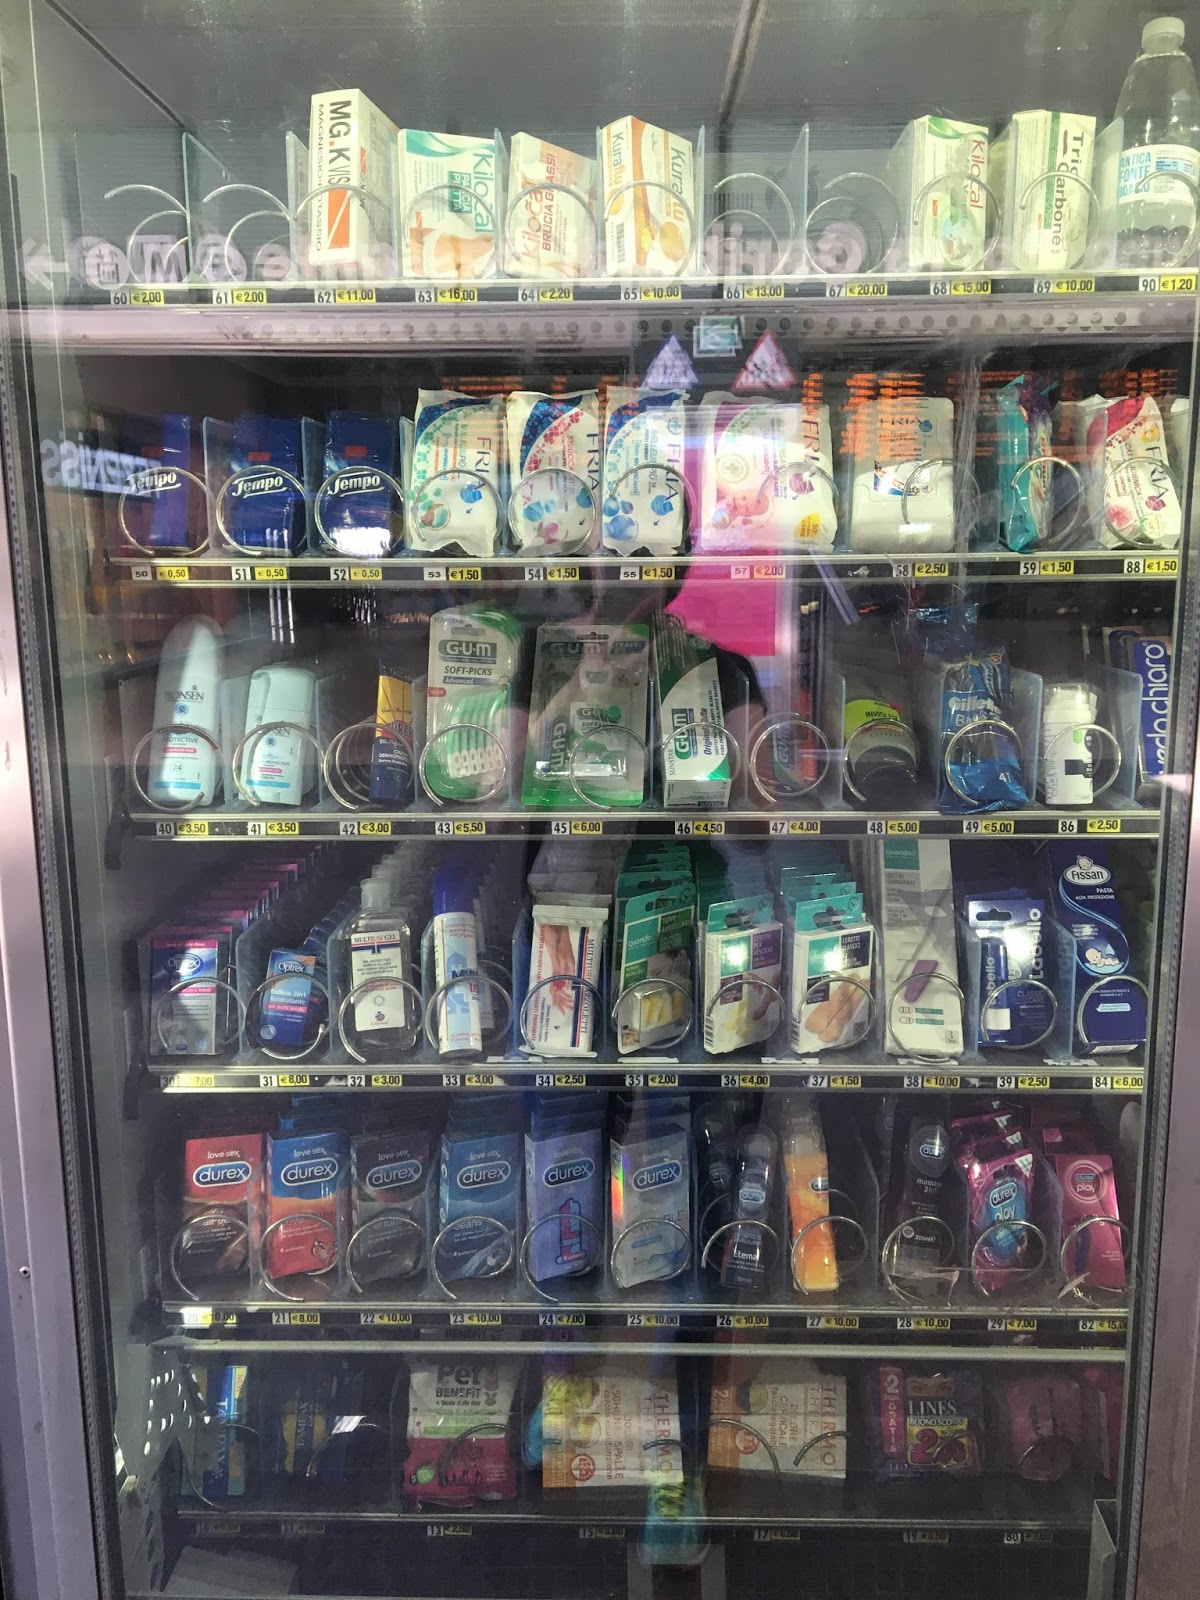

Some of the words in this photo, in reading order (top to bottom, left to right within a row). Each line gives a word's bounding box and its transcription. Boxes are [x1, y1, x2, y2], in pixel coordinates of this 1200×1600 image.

[1120, 152, 1151, 168] ANTICA
[1120, 165, 1150, 182] FONTE
[541, 204, 555, 252] BRUCIA
[828, 284, 843, 297] 67
[932, 282, 947, 295] 68
[1036, 280, 1051, 293] 69
[1141, 279, 1156, 292] 90
[318, 290, 332, 304] 62
[418, 290, 432, 302] 63
[521, 289, 535, 302] 64
[623, 288, 637, 300] 65
[726, 285, 740, 298] 66
[113, 291, 127, 304] 60
[215, 291, 228, 304] 61
[128, 471, 178, 493] Tempo
[232, 474, 284, 498] Tempo
[329, 473, 381, 497] Tempo
[1023, 561, 1037, 574] 59
[1127, 561, 1141, 573] 88
[135, 570, 148, 578] 50
[235, 568, 247, 580] 51
[333, 569, 347, 580] 52
[428, 570, 441, 578] 53
[528, 568, 541, 580] 54
[623, 570, 637, 578] 55
[444, 665, 493, 676] SOFT-PICKS
[444, 677, 474, 685] Advanced
[948, 695, 1001, 715] Gillette
[702, 727, 712, 755] Original
[668, 748, 676, 776] SUNSTAR
[158, 823, 172, 834] 40
[250, 823, 261, 834] 41
[342, 823, 355, 834] 42
[438, 823, 451, 834] 43
[554, 823, 567, 834] 45
[677, 823, 690, 834] 46
[771, 822, 785, 833] 47
[869, 822, 883, 833] 48
[965, 822, 979, 833] 49
[1061, 820, 1074, 832] 86
[886, 848, 911, 856] Quando
[1070, 870, 1104, 880] Fissan
[384, 933, 397, 941] GEL
[627, 934, 652, 948] Quando
[842, 935, 861, 944] CEROTTI
[585, 938, 595, 981] MULTIUSI
[278, 962, 305, 973] Optrex
[580, 981, 592, 1034] AZZOLETTI
[262, 1076, 273, 1086] 31
[350, 1076, 362, 1086] 32
[445, 1075, 458, 1086] 33
[538, 1075, 551, 1086] 34
[628, 1075, 641, 1086] 35
[723, 1075, 737, 1086] 36
[812, 1076, 825, 1086] 37
[906, 1076, 919, 1086] 38
[999, 1077, 1012, 1087] 39
[1094, 1077, 1108, 1088] 84
[207, 1150, 223, 1158] love
[224, 1149, 240, 1158] sex
[293, 1148, 311, 1157] love
[311, 1147, 327, 1155] sex
[378, 1152, 395, 1161] love
[395, 1149, 410, 1158] sex
[469, 1152, 485, 1161] love
[486, 1150, 500, 1158] sex
[198, 1164, 246, 1182] durex
[286, 1162, 337, 1181] durex
[371, 1166, 417, 1185] durex
[462, 1165, 505, 1184] durex
[547, 1163, 592, 1182] durex
[636, 1166, 676, 1186] durex
[992, 1186, 1015, 1204] durex
[274, 1313, 286, 1323] 21
[363, 1313, 375, 1323] 22
[452, 1313, 465, 1323] 23
[541, 1314, 554, 1325] 24
[629, 1314, 642, 1325] 25
[719, 1316, 732, 1327] 26
[809, 1317, 821, 1327] 27
[899, 1317, 912, 1328] 28
[990, 1318, 1003, 1329] 29
[1081, 1319, 1094, 1330] 82
[437, 1364, 482, 1385] Pet
[908, 1400, 957, 1415] LINES
[822, 1386, 837, 1466] THERMO
[656, 1393, 673, 1473] THERMO
